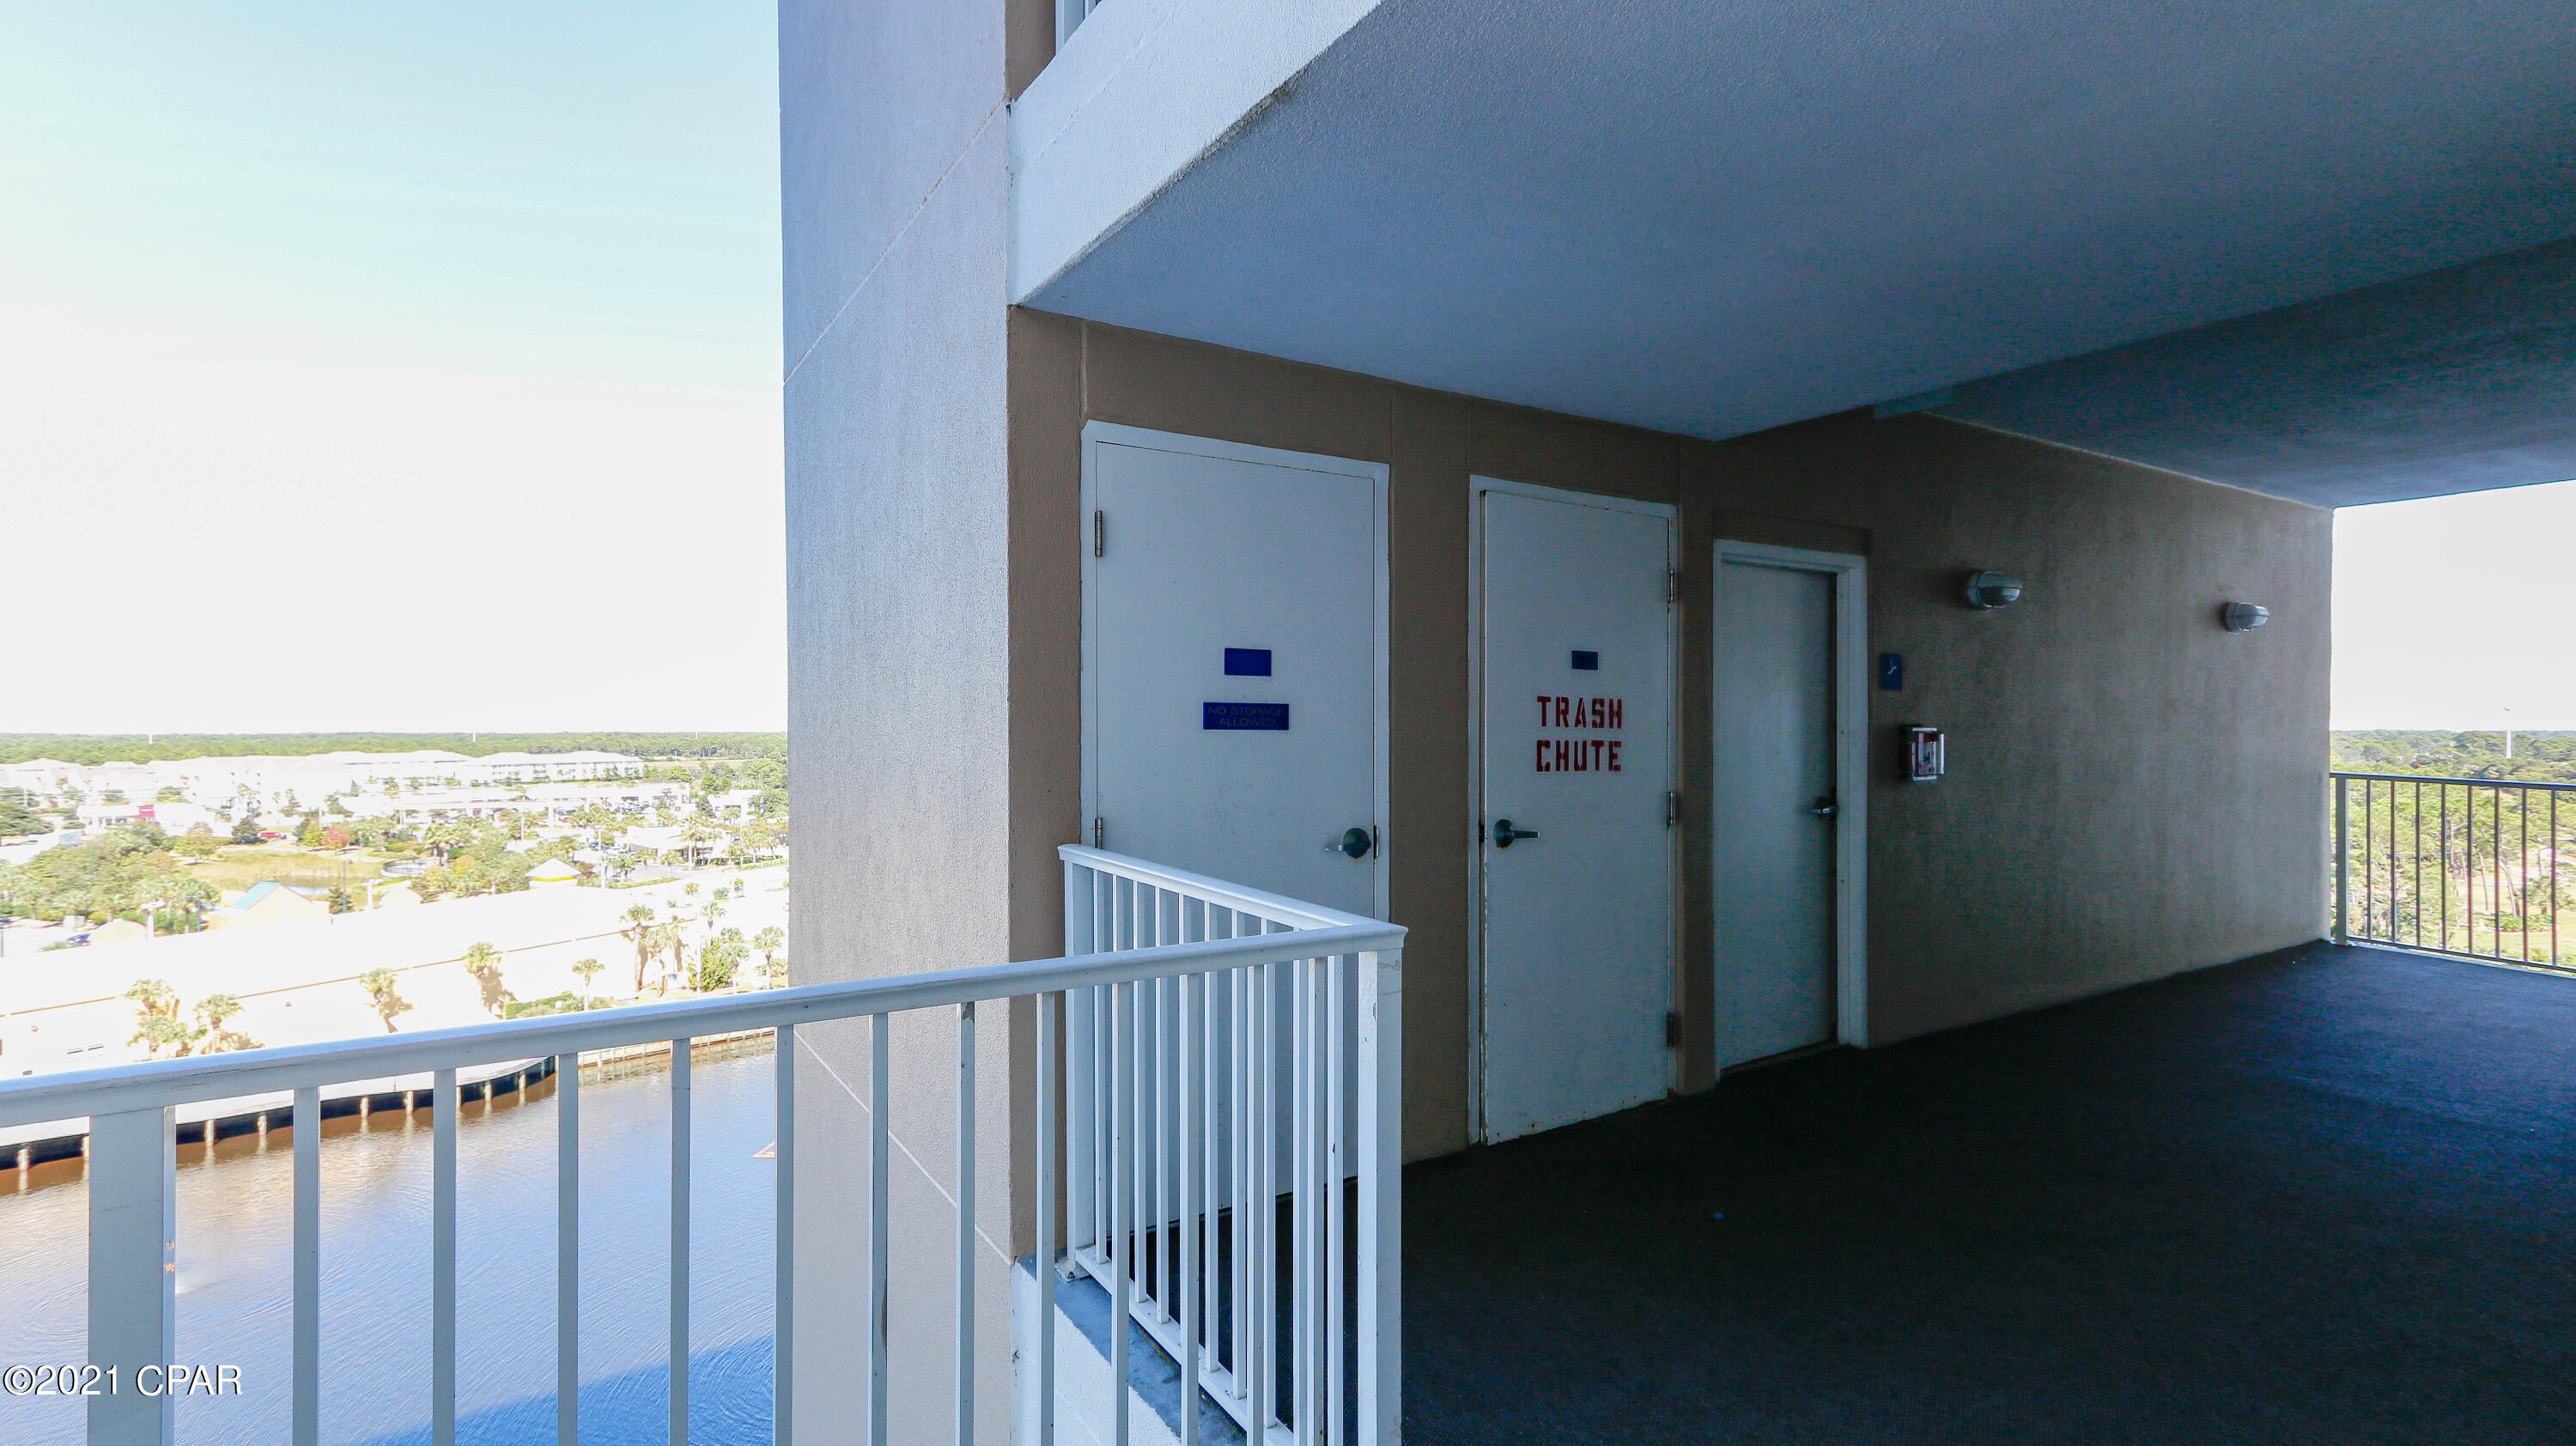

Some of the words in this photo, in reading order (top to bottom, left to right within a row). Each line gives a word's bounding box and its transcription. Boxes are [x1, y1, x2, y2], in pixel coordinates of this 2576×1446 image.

[1208, 707, 1226, 715] NO
[1230, 707, 1285, 715] STORAGE
[1536, 696, 1623, 729] TRASH
[1219, 718, 1276, 726] ALLOWED
[1536, 739, 1622, 772] CHUTE
